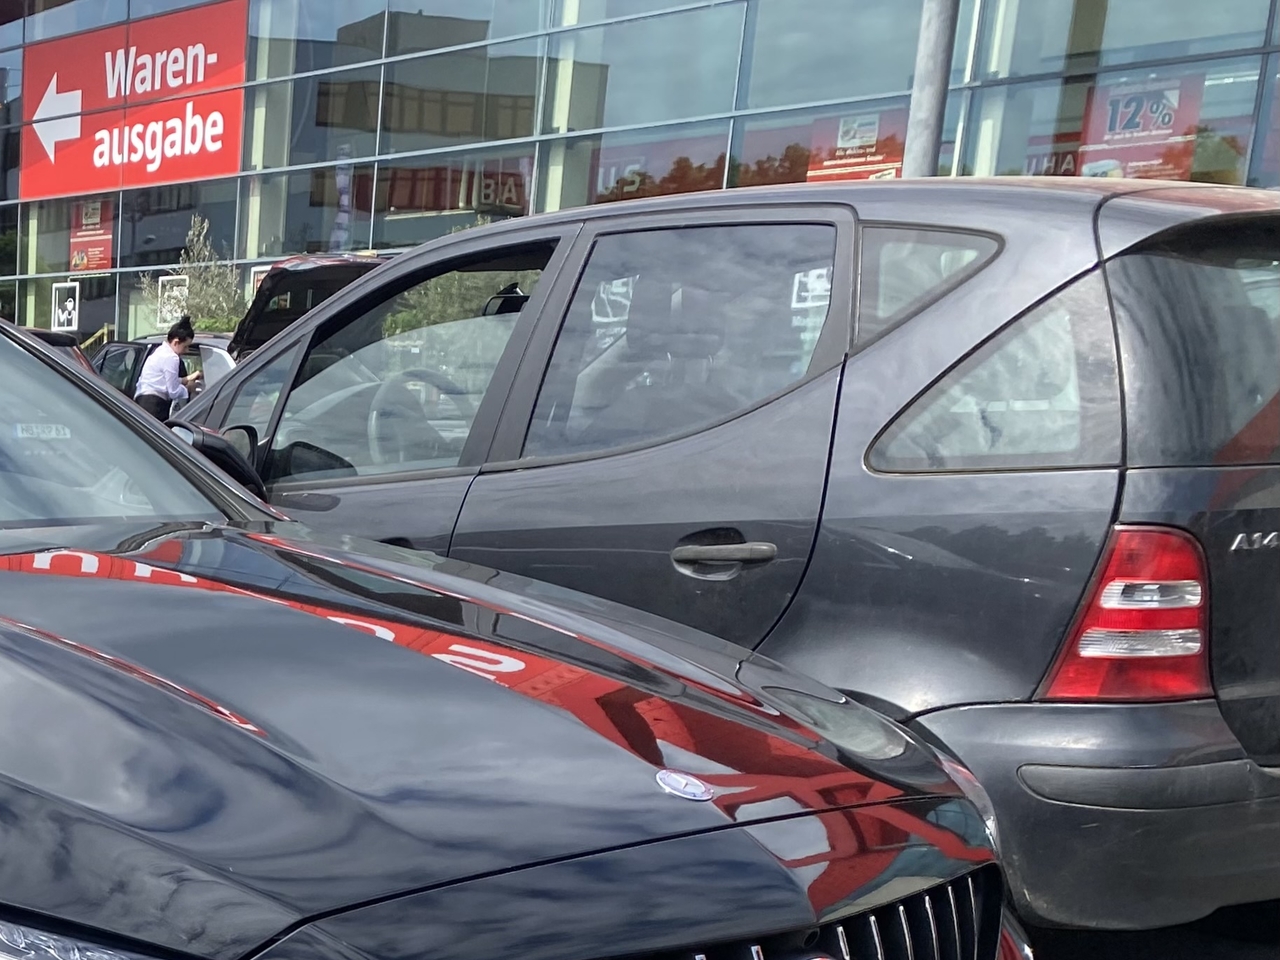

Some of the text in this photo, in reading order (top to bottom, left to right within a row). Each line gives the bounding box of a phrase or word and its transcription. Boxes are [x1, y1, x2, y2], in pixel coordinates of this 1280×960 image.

[105, 42, 218, 99] Waren-
[93, 101, 224, 173] ausgabe
[1106, 94, 1174, 133] 12%
